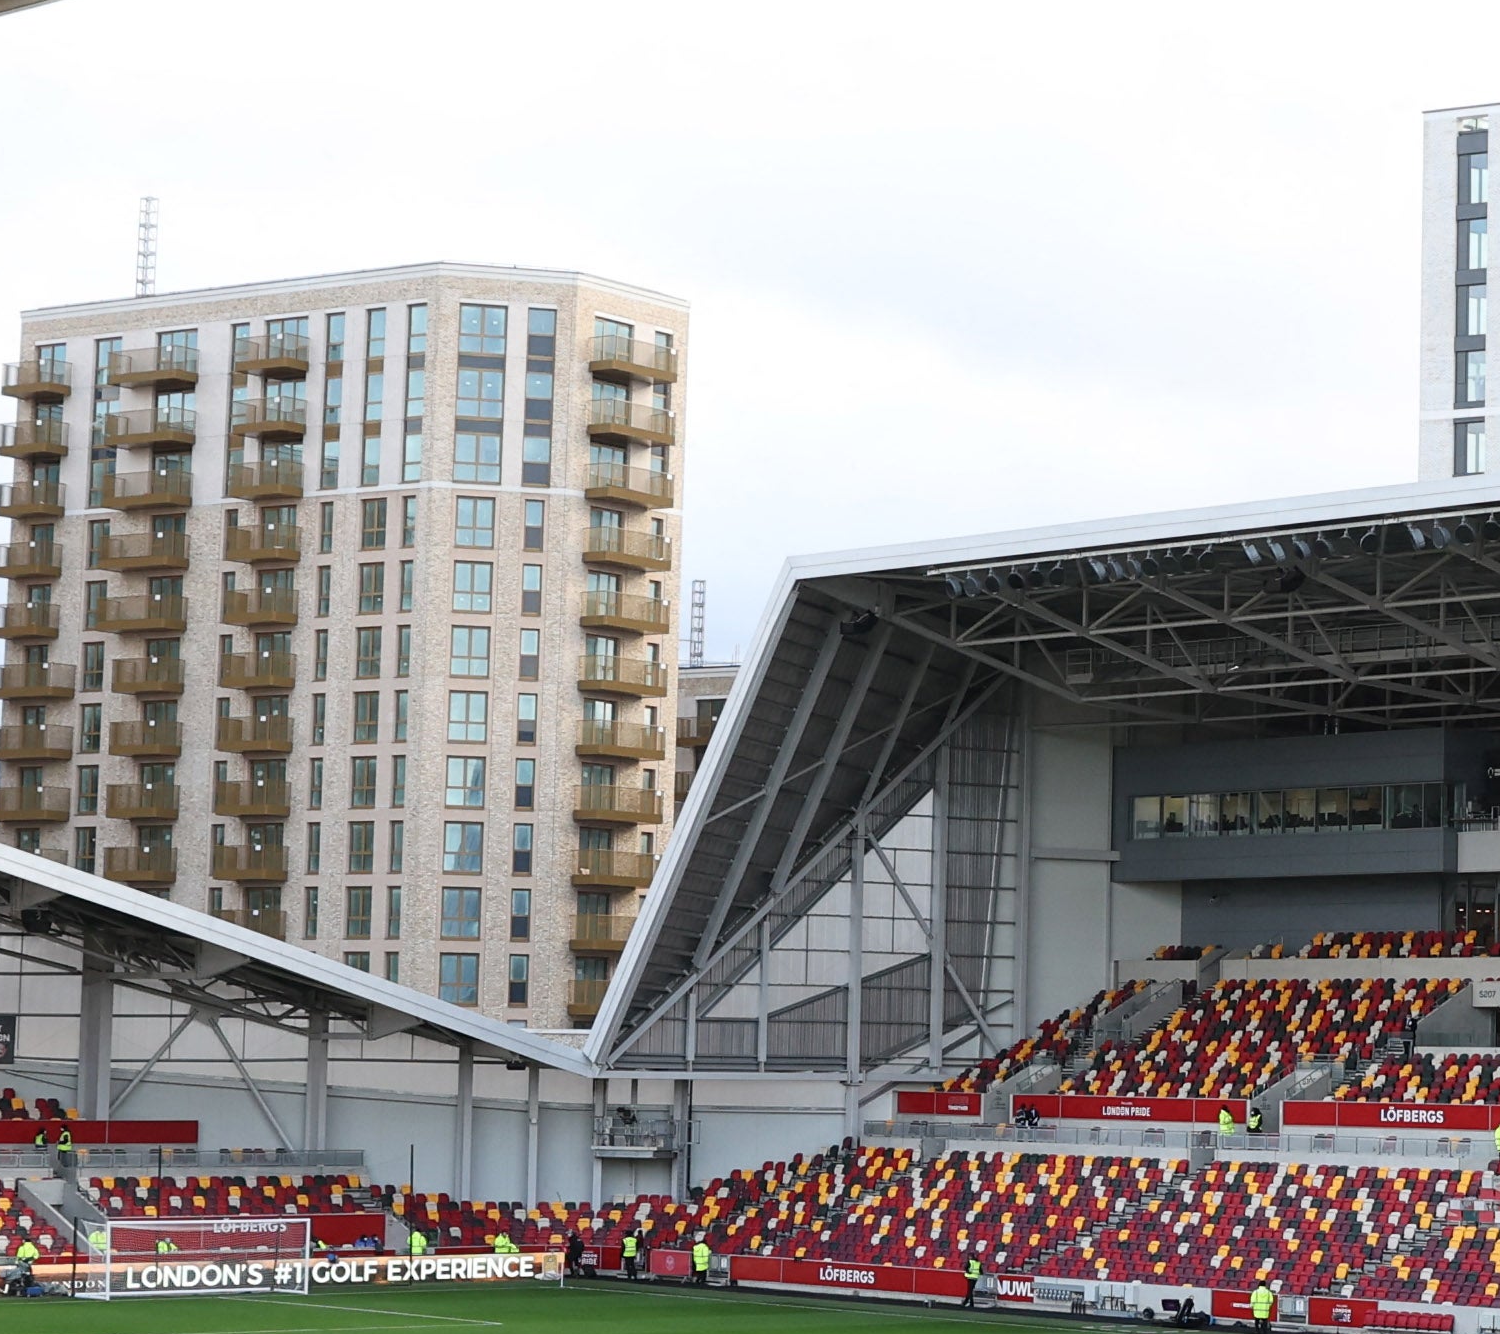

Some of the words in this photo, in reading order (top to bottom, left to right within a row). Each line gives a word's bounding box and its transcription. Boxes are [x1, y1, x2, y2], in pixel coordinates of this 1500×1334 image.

[1102, 1106, 1130, 1116] LONDON
[1131, 1107, 1151, 1117] PRIDE
[1380, 1107, 1444, 1123] LÖFBERGS
[126, 1262, 264, 1289] LONDON'S
[274, 1261, 303, 1285] #1
[311, 1259, 379, 1284] GOLF
[387, 1255, 535, 1282] EXPERIENCE
[819, 1266, 875, 1284] LÖFBERGS
